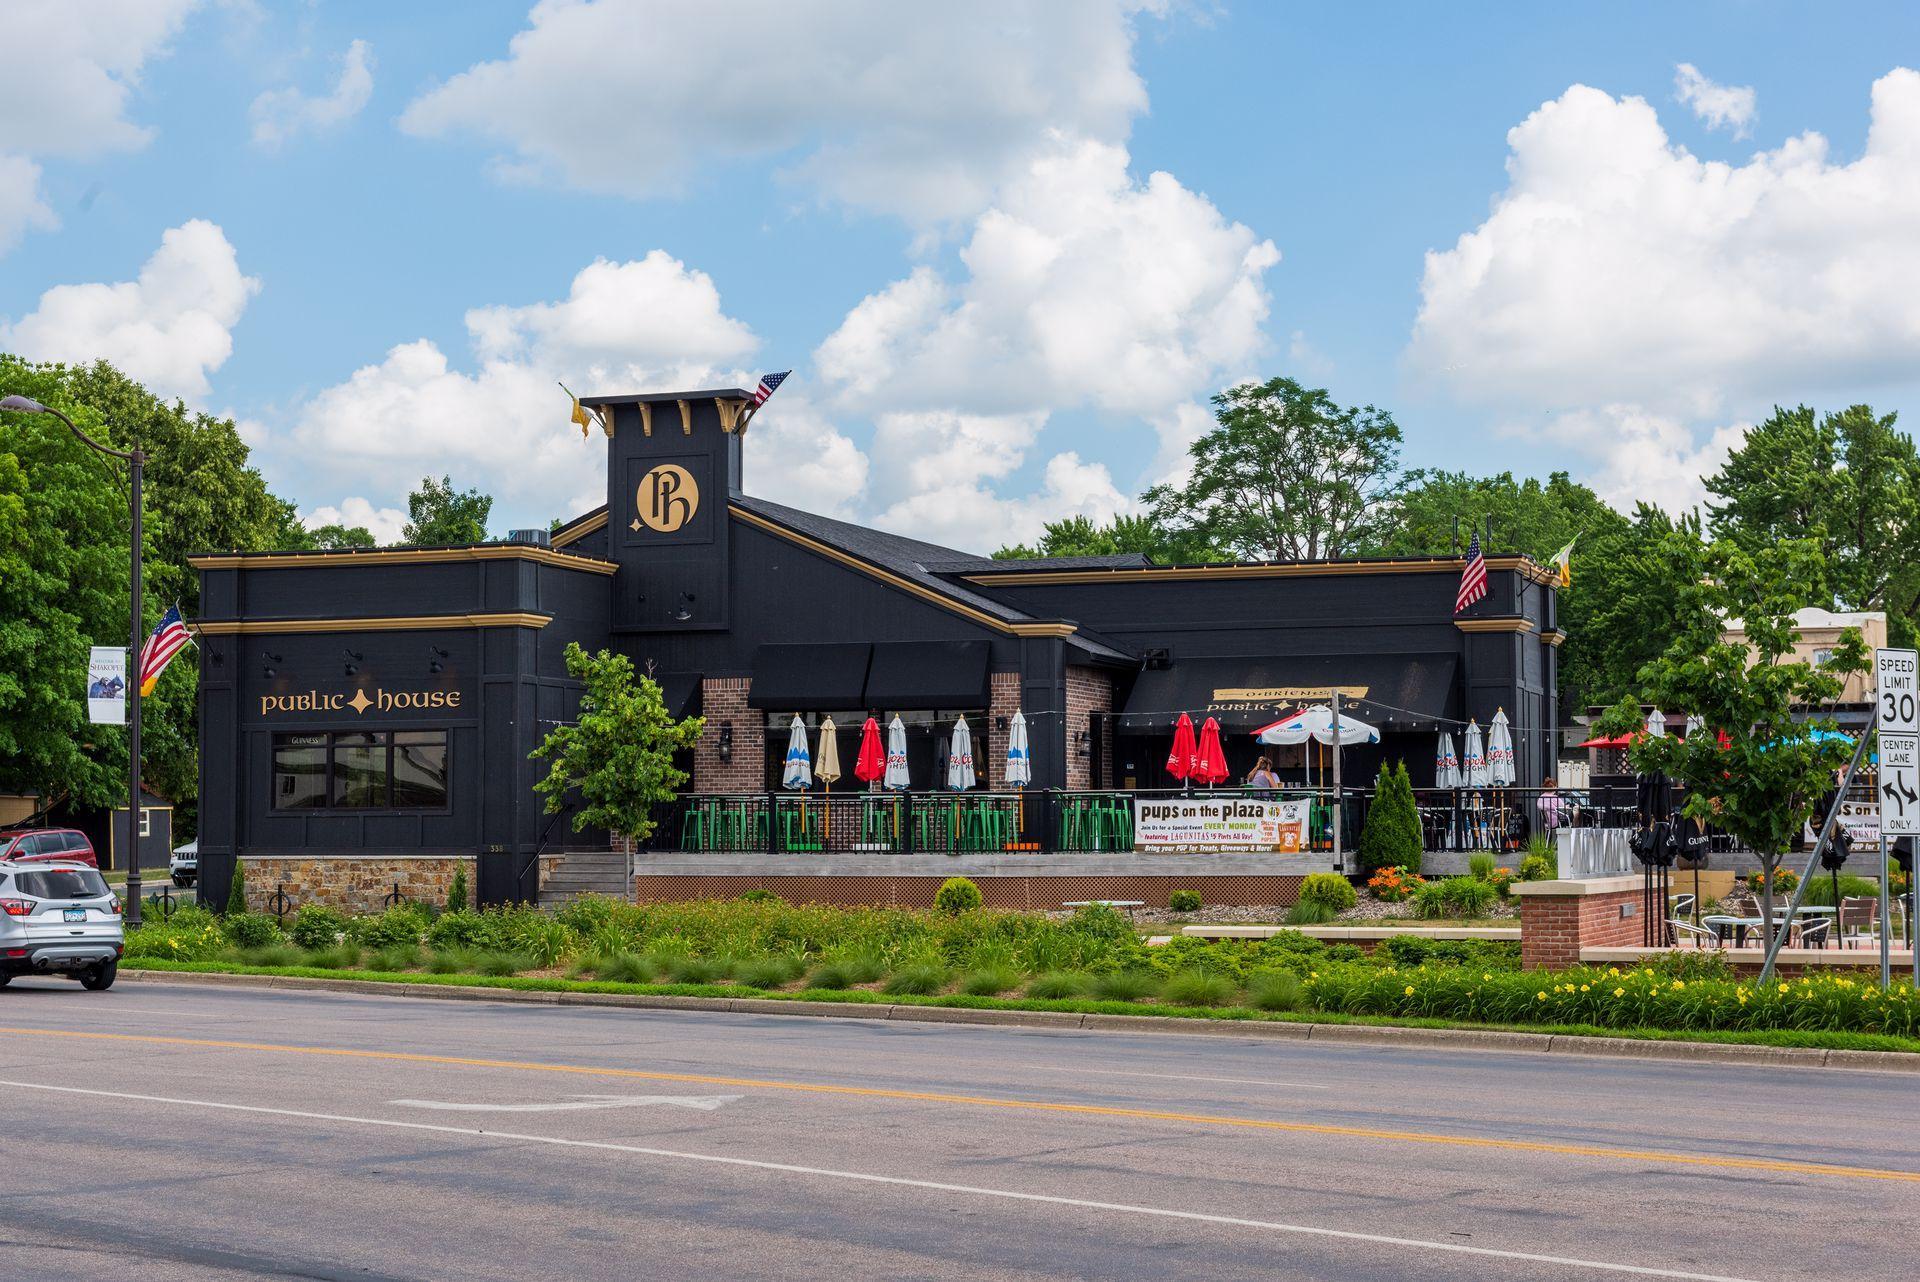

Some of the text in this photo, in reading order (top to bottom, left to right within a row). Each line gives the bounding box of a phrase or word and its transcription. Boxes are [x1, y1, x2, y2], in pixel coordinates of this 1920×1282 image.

[1880, 659, 1914, 673] SPEED
[1884, 677, 1911, 690] LIMIT
[1882, 693, 1915, 723] 30
[1883, 740, 1914, 750] CENTER
[1888, 753, 1910, 764] LANE
[1141, 801, 1264, 822] pups on the plaza
[1855, 807, 1871, 816] on
[1204, 822, 1226, 830] EVERY
[1228, 822, 1257, 830] MONDAY
[1890, 819, 1911, 830] ONLY
[1144, 833, 1168, 841] featuring
[1170, 832, 1209, 840] LAGUNITAS
[1220, 845, 1250, 853] Giveaways
